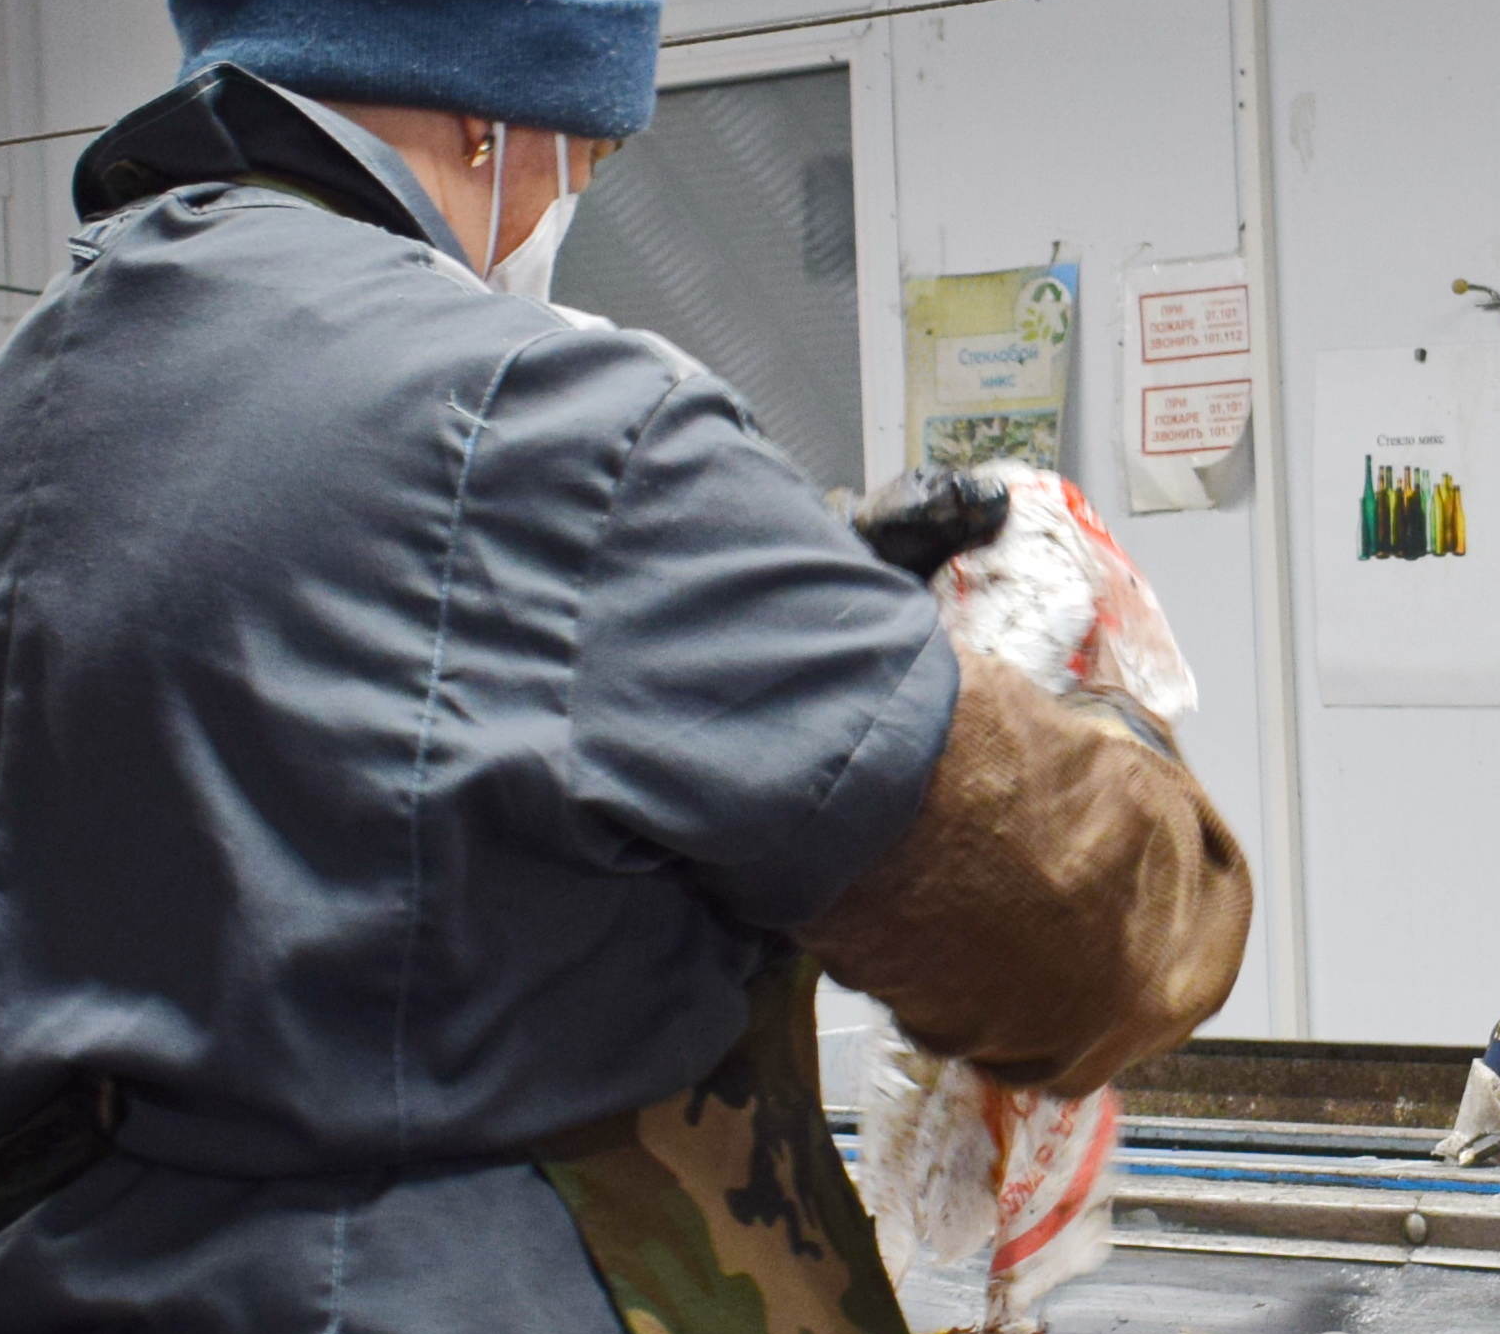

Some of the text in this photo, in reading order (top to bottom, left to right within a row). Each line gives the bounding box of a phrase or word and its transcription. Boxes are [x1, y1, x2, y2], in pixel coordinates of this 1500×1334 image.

[1161, 304, 1184, 316] ПРИ
[1150, 318, 1195, 333] ПОЖАРЕ
[1149, 335, 1199, 350] ЗВОНИТЬ
[959, 344, 1039, 365] Стеклобой
[1165, 397, 1188, 409] ПРИ
[1154, 411, 1200, 426] ПОЖАРЕ
[1151, 428, 1203, 442] ЗВОНИТЬ
[1377, 434, 1445, 447] Стекло микс
